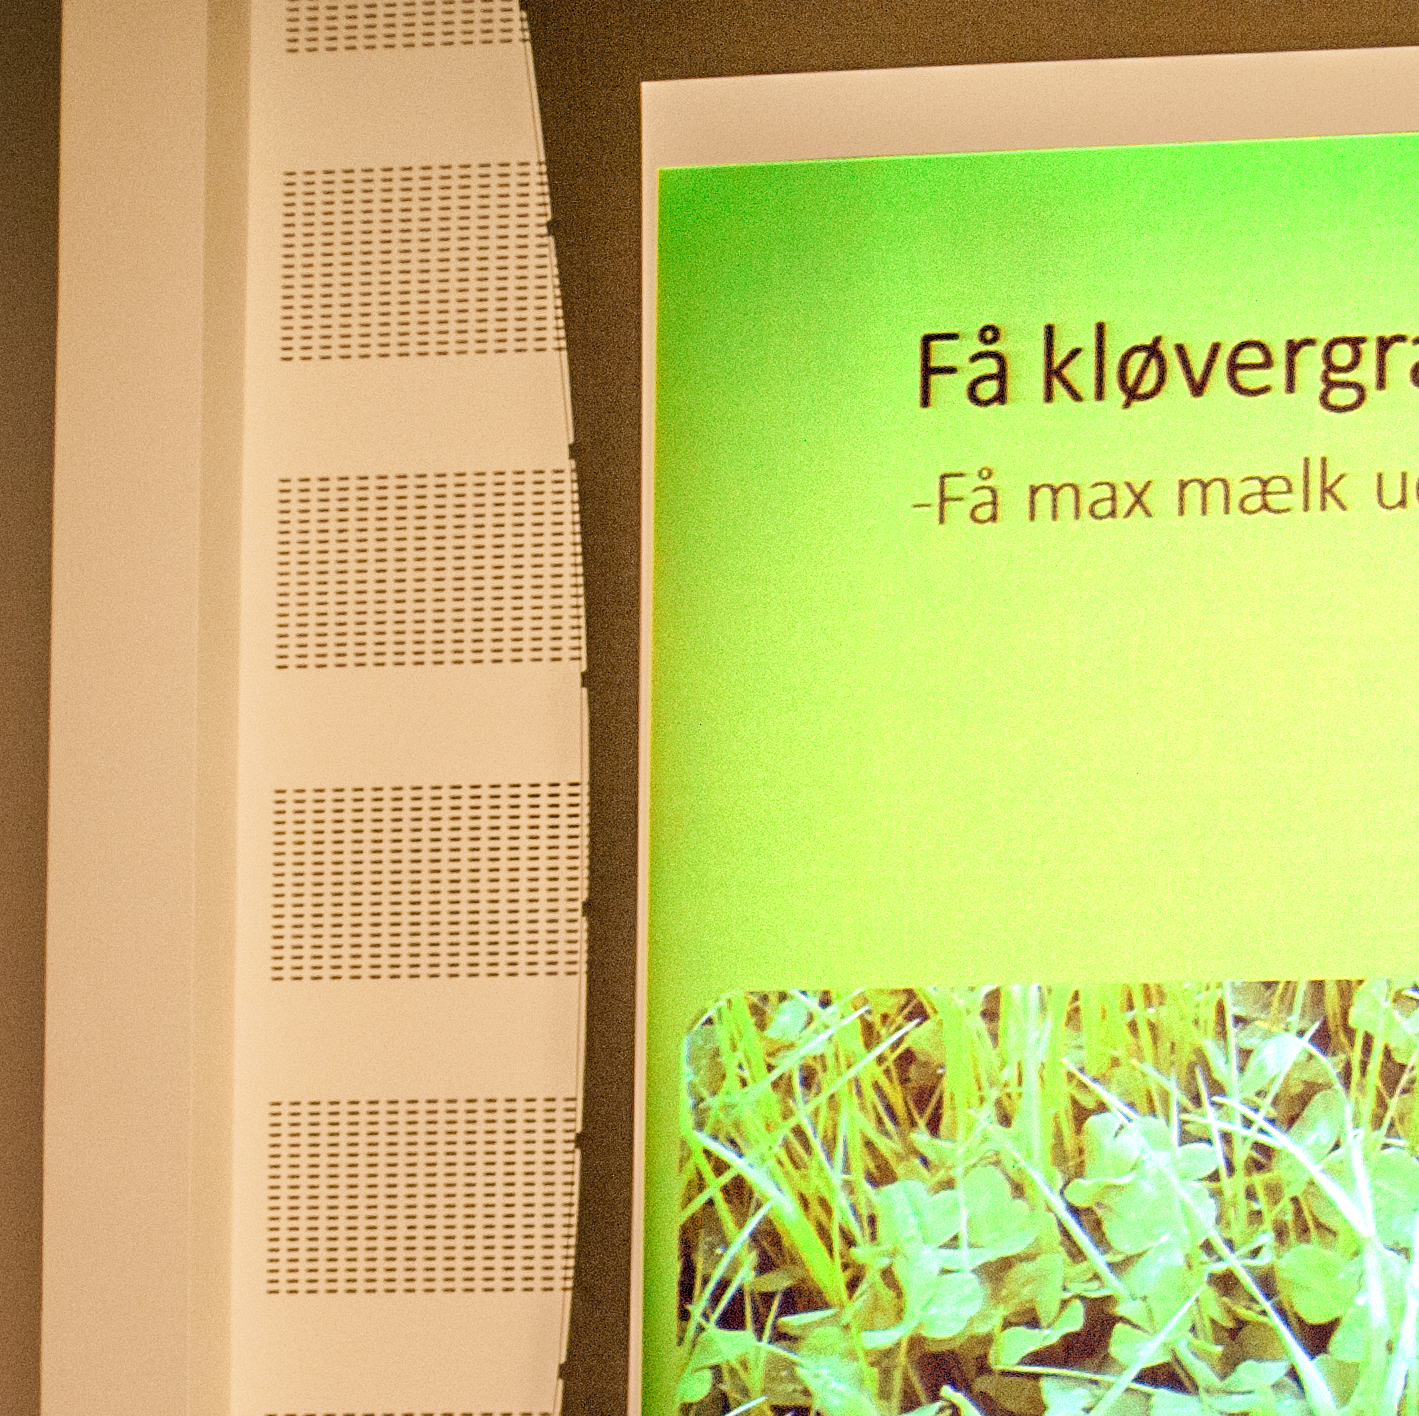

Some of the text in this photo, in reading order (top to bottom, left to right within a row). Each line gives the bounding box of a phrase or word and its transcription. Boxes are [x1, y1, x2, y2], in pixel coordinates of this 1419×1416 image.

[918, 322, 1010, 410] Få
[911, 466, 1002, 526] -Få
[1027, 479, 1153, 523] max
[1176, 455, 1349, 518] mælk
